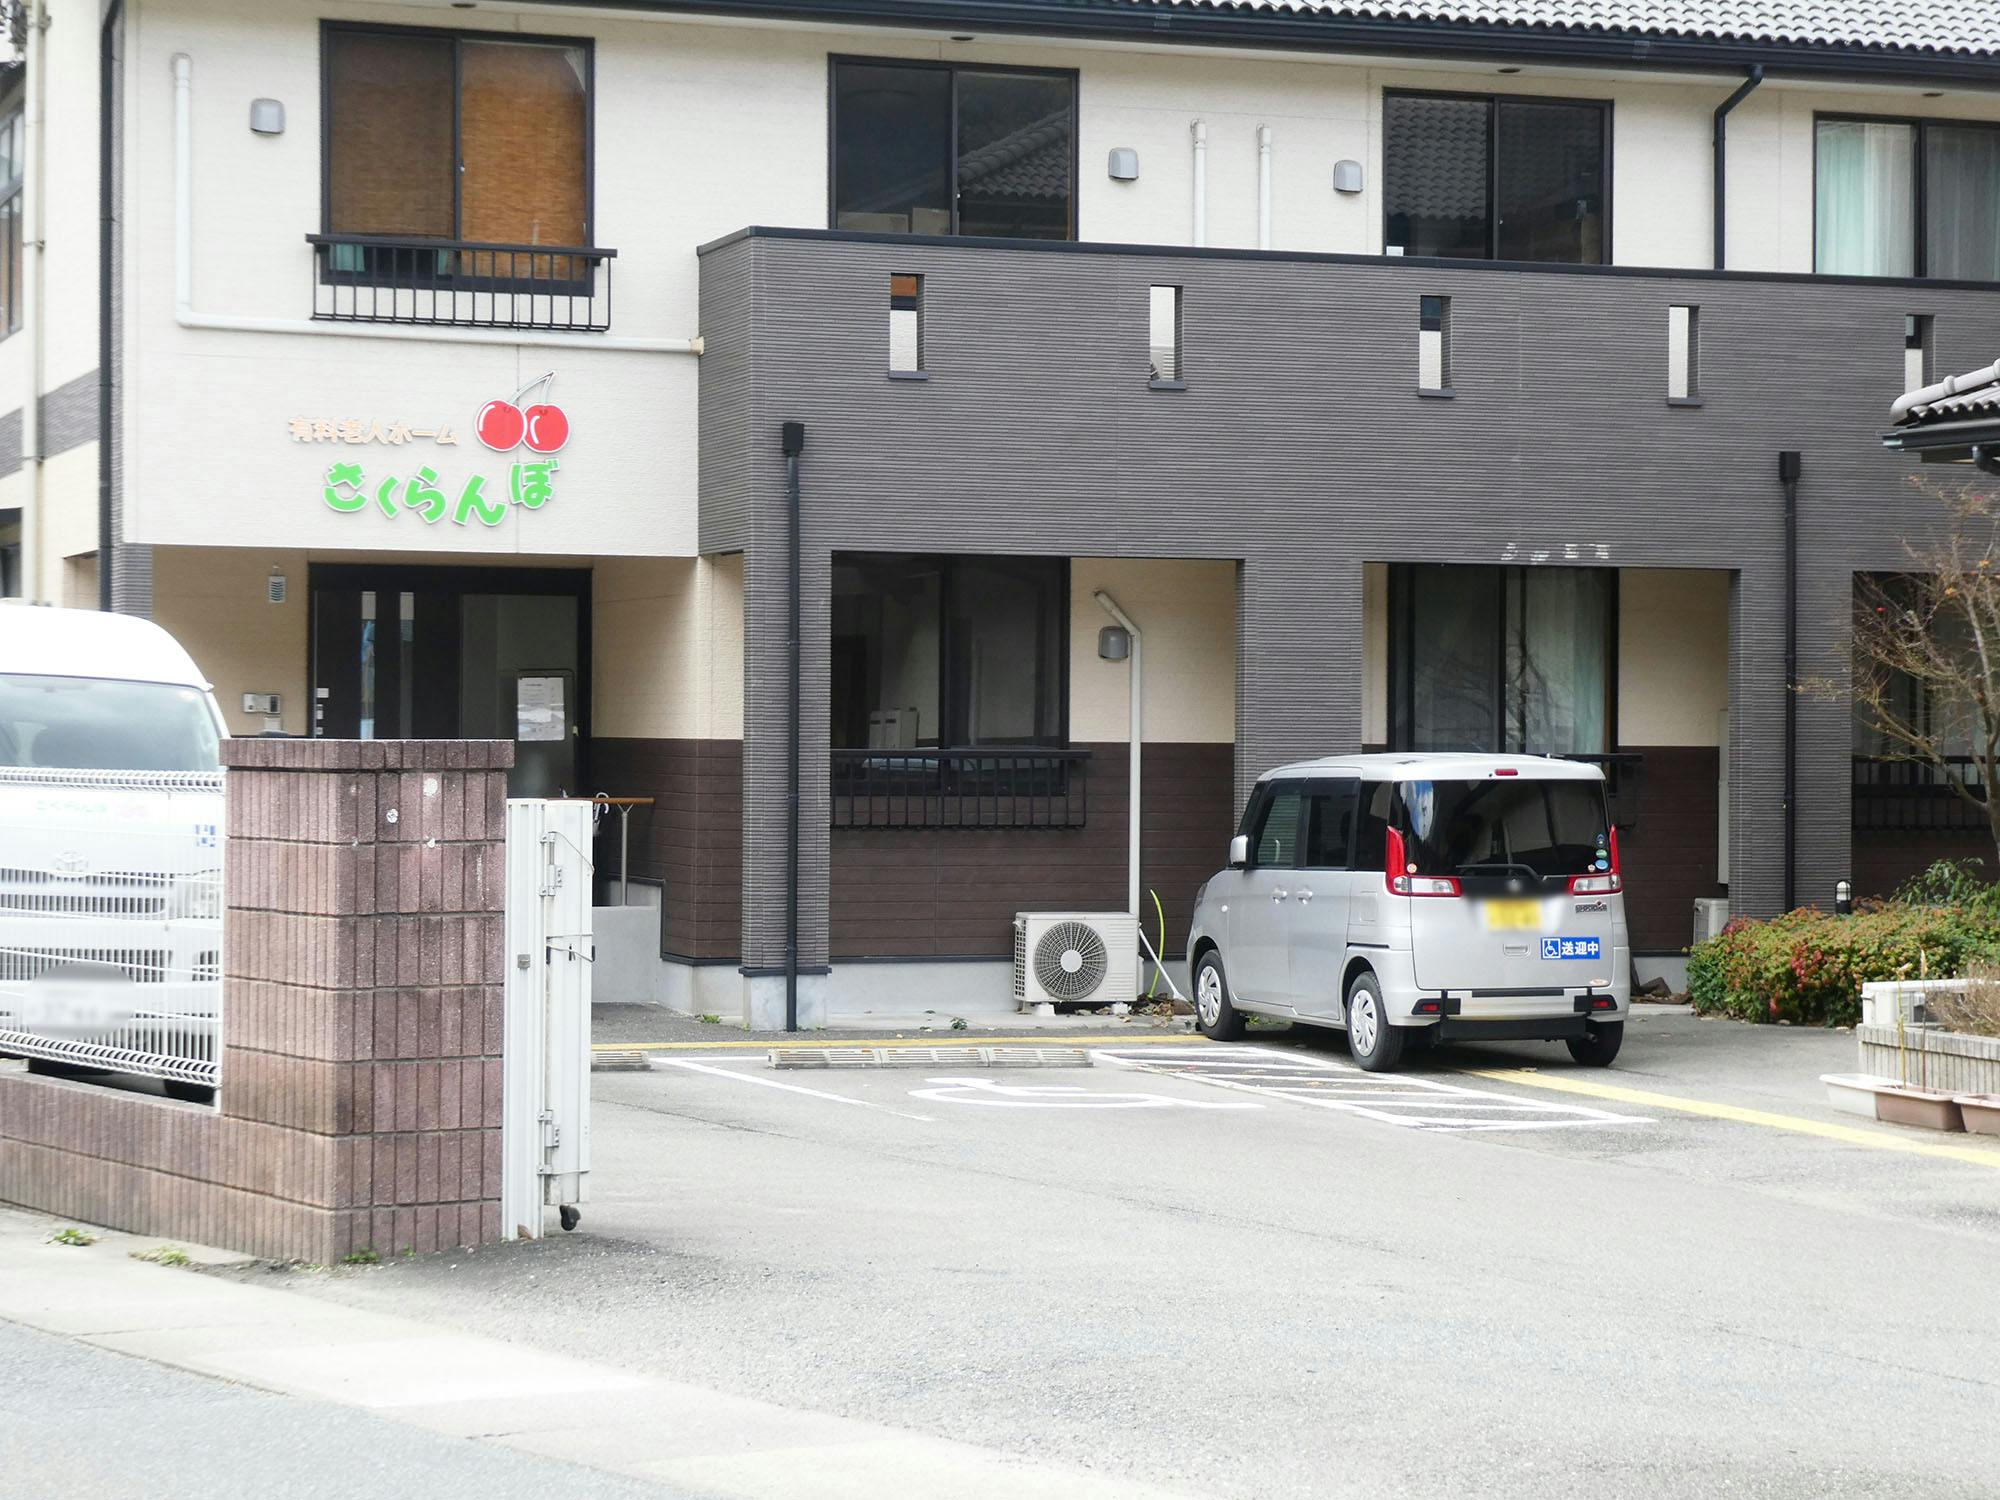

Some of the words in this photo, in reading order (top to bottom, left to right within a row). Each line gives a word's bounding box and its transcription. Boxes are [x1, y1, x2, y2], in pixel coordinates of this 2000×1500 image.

[288, 415, 459, 446] 有料老人ホーム
[322, 458, 560, 527] さくらんぼ
[1561, 940, 1599, 956] 送迎中
